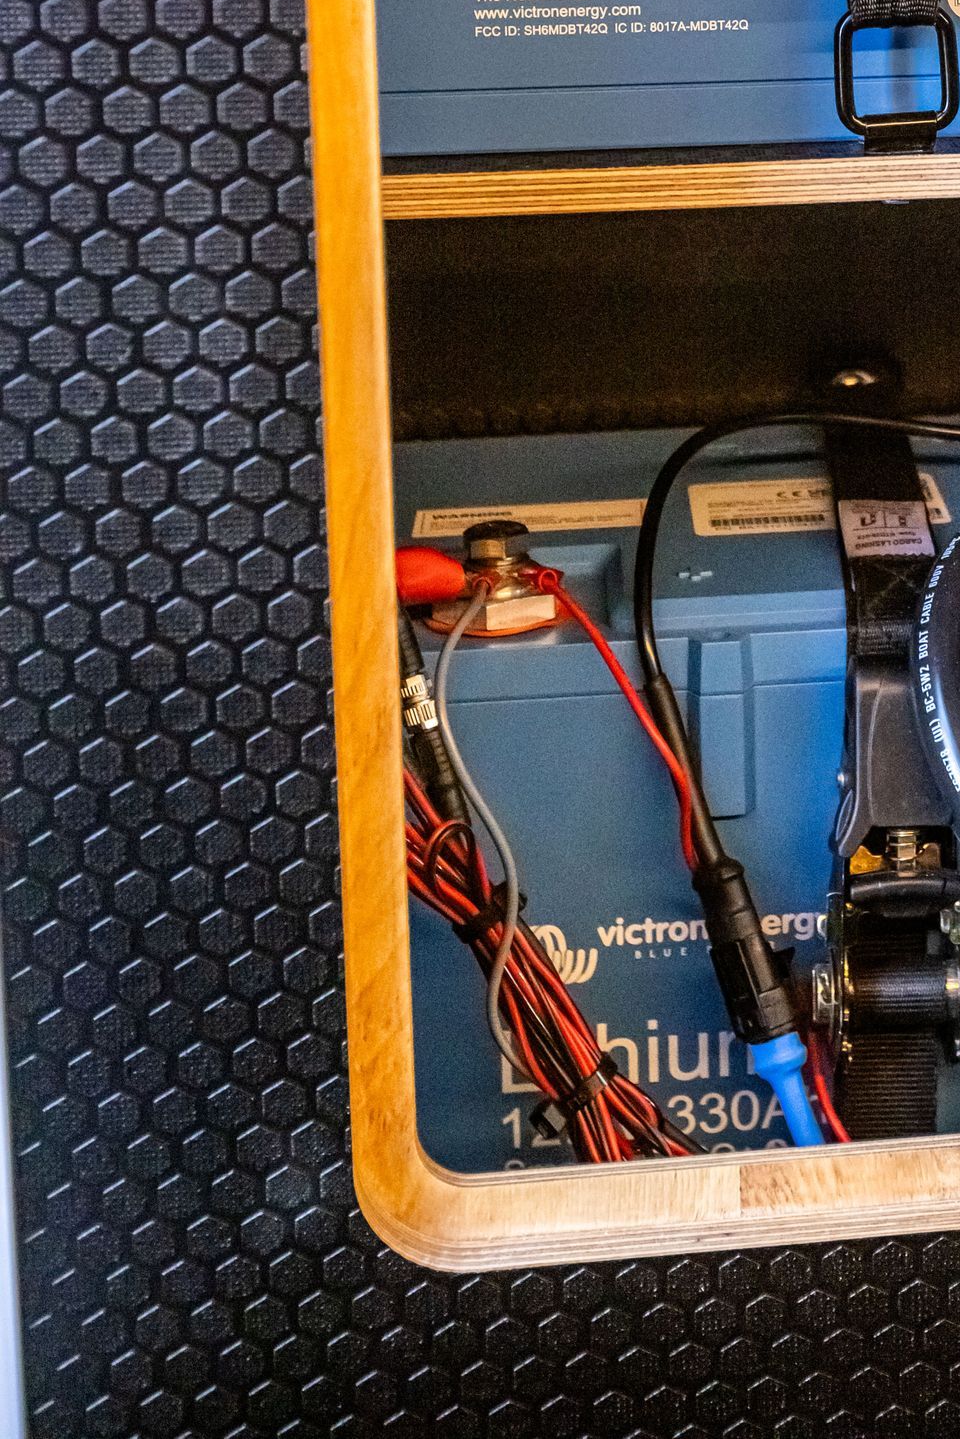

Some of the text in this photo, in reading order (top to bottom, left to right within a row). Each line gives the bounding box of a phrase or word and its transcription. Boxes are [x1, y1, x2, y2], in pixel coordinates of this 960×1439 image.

[474, 5, 641, 20] www.victronenergy.com
[475, 19, 748, 37] FCC ID: SH6MDBT42Q IC ID: 8017A-MDBT42Q
[921, 592, 934, 625] CABLE
[919, 630, 928, 660] BOAT
[920, 664, 936, 713] BC-5W2
[929, 718, 944, 742] (UL)
[597, 917, 710, 947] victron
[635, 947, 687, 960] BLUE
